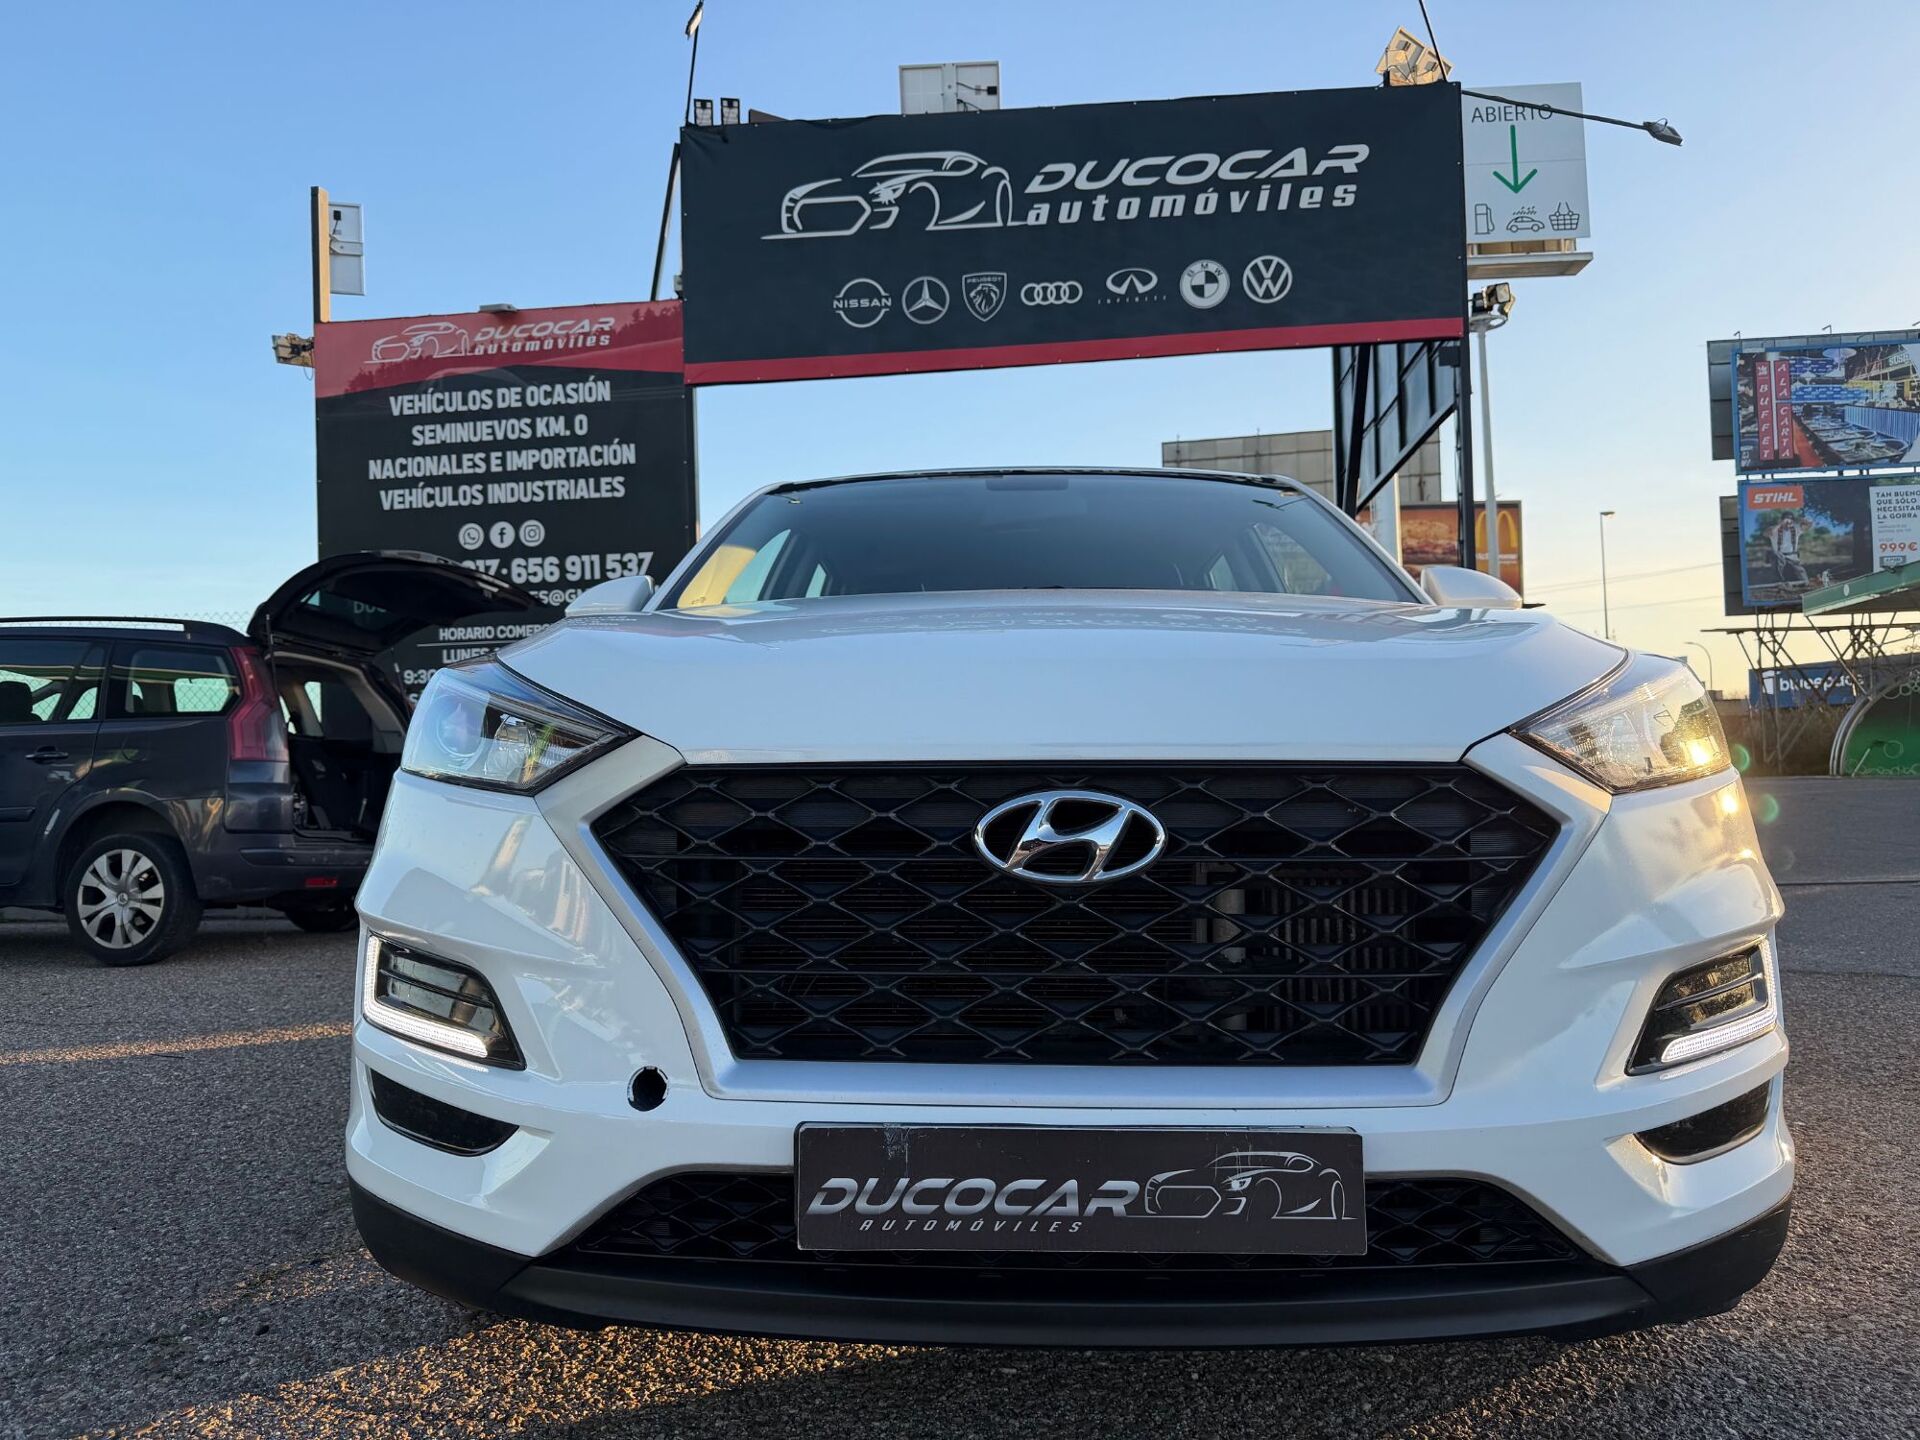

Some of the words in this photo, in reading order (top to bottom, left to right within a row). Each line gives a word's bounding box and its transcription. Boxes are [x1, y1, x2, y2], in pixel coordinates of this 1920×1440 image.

[1471, 103, 1553, 124] ABIERTO
[1024, 144, 1370, 193] DUCOCAR
[1026, 184, 1358, 226] automóviles
[833, 297, 892, 309] NISSAN
[474, 317, 615, 342] DUCOCAR
[389, 387, 493, 416] VEHÍCULOS
[497, 387, 522, 409] DE
[525, 375, 611, 407] OCASIÓN
[411, 418, 532, 446] SEMINUEVOS
[536, 415, 571, 438] KM.
[1759, 384, 1770, 458] BUFFET
[1780, 406, 1790, 458] CARTA
[368, 452, 486, 480] NACIONALES
[490, 451, 503, 472] E
[506, 438, 636, 472] IMPORTACIÓN
[380, 482, 484, 511] VEHÍCULOS
[487, 476, 626, 504] INDUSTRIALES
[1753, 492, 1798, 504] STIHL
[1895, 496, 1917, 505] SÓLO
[1889, 512, 1918, 520] GORRA
[511, 556, 560, 585] 656
[565, 554, 600, 582] 911
[605, 551, 654, 580] 537
[438, 625, 495, 640] HORARIO
[806, 1177, 1141, 1217] DUCOCAR
[858, 1217, 1083, 1233] AUTOMÓVILES
